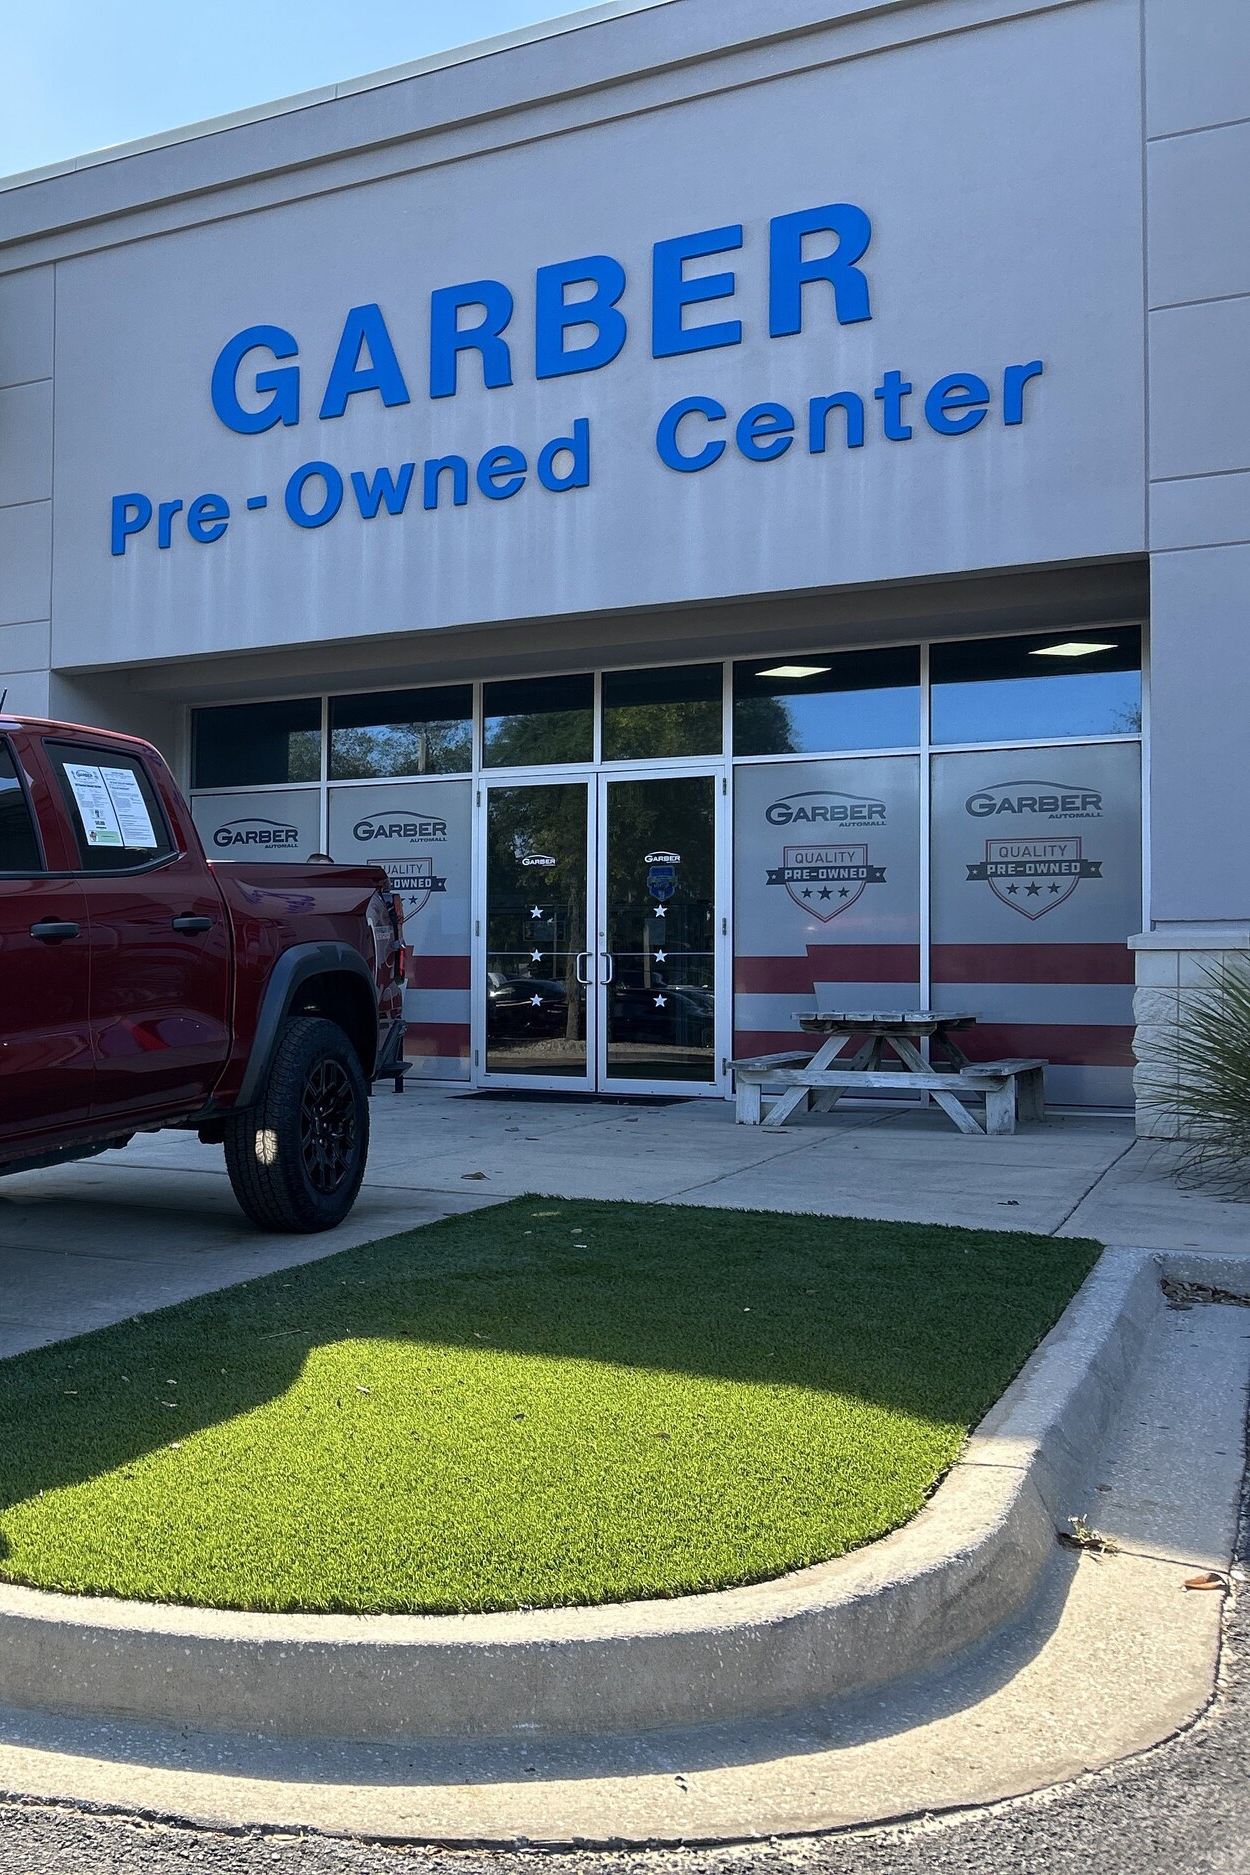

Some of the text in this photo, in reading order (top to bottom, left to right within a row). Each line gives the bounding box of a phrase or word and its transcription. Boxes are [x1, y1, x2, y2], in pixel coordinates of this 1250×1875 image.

[211, 203, 873, 435] GARBER
[111, 360, 1043, 556] Pre-Owned Center
[965, 793, 1103, 818] GARBER
[765, 802, 887, 826] GARBER
[1048, 812, 1103, 820] AUTOMALL
[213, 828, 299, 848] GARBER
[353, 821, 447, 842] GARBER
[644, 855, 681, 863] GARBER
[794, 851, 856, 864] QUALITY
[998, 844, 1068, 859] QUALITY
[384, 863, 423, 875] UALITY
[784, 867, 868, 880] PRE-OWNED
[986, 862, 1081, 875] PRE-OWNED
